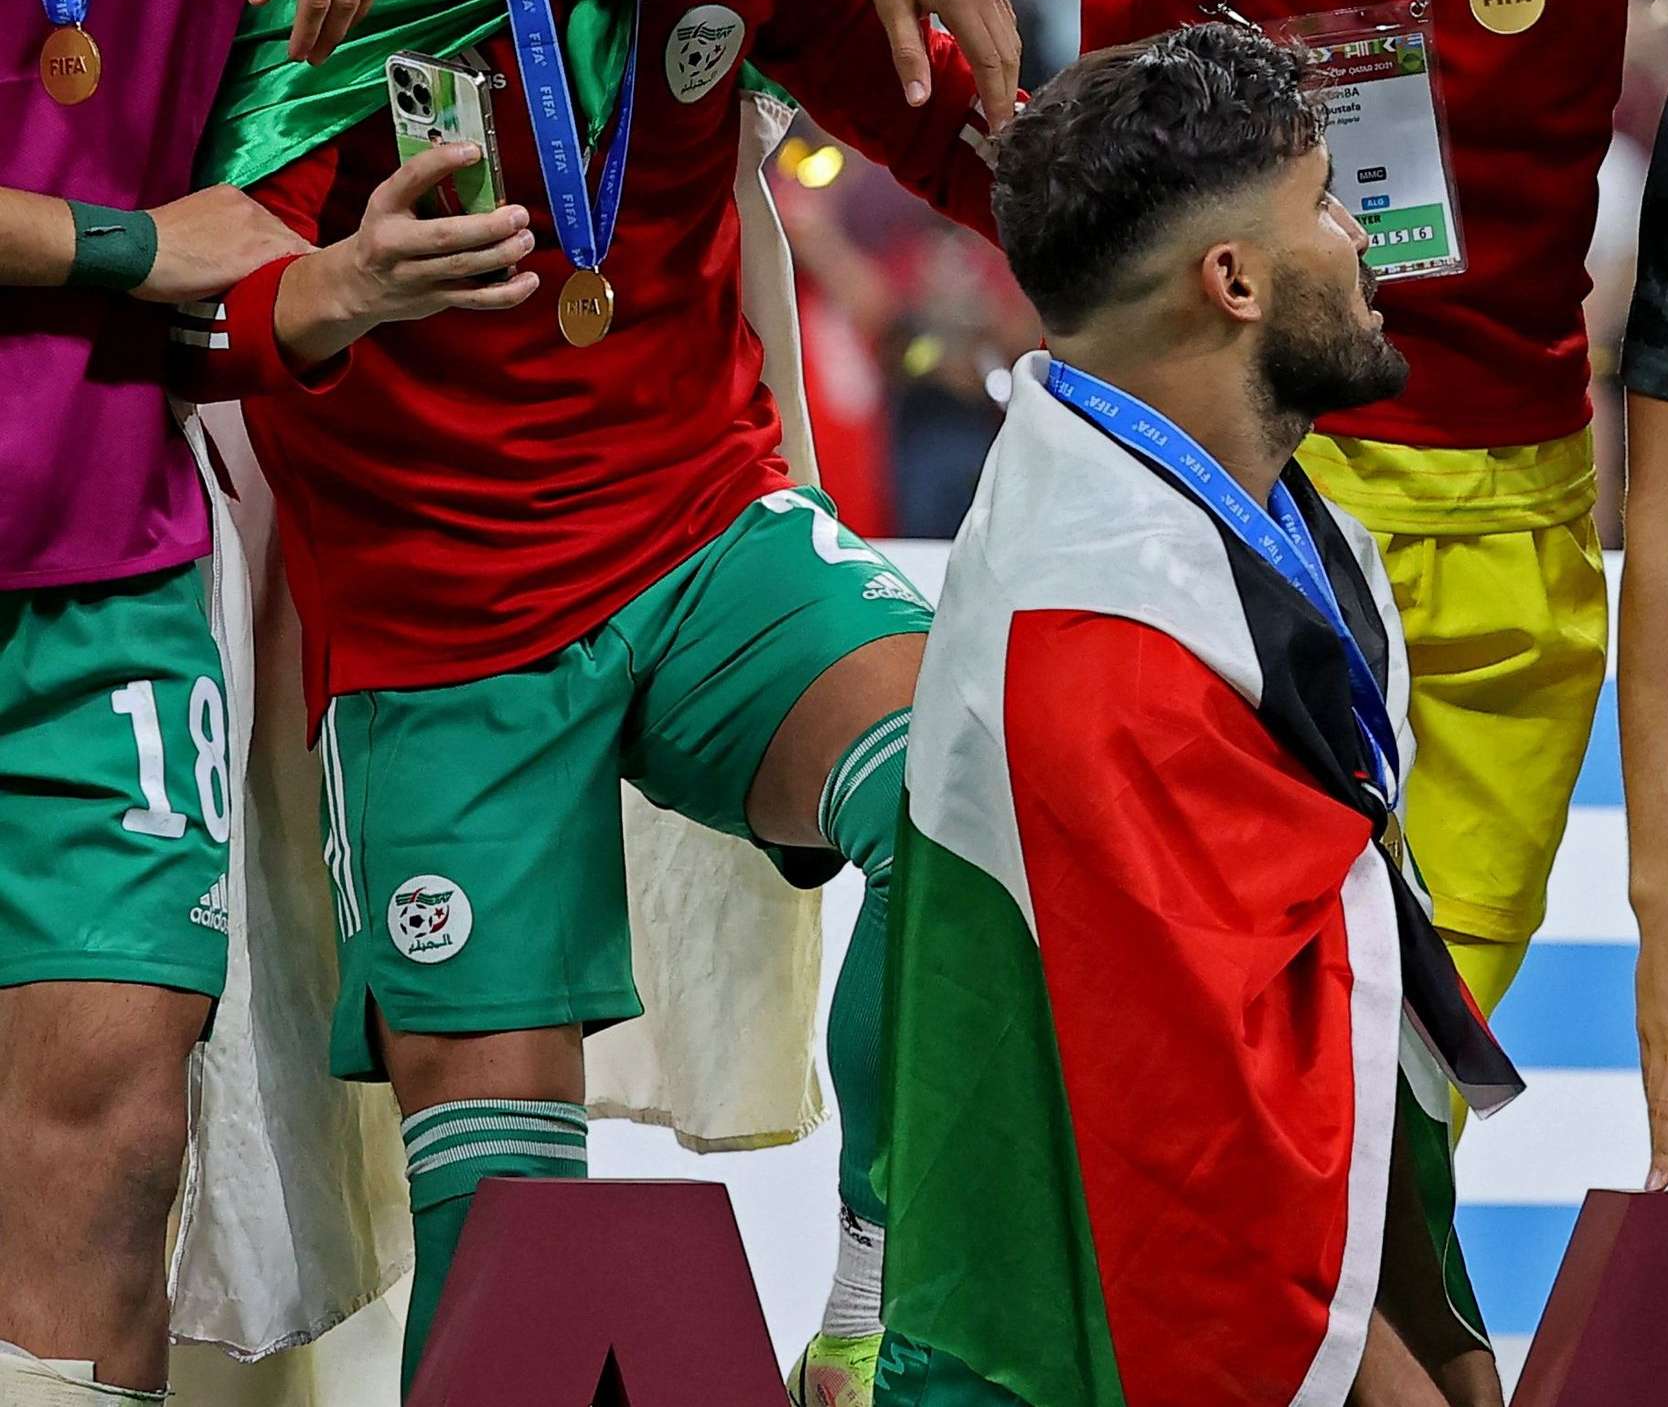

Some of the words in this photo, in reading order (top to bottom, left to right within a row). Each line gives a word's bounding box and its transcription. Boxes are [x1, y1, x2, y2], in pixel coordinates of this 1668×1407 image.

[529, 33, 546, 66] FIFA
[50, 56, 87, 76] FIFA
[540, 86, 557, 120] FIFA
[552, 140, 567, 174] FIFA
[1359, 169, 1384, 180] MMC
[563, 194, 577, 228] FIFA
[1355, 215, 1381, 225] AYER
[1371, 235, 1379, 245] 4
[1396, 232, 1403, 242] 5
[1420, 228, 1427, 239] 6
[1085, 395, 1120, 417] FIFA
[1133, 420, 1168, 447] FIFA
[1180, 454, 1211, 483] FIFA
[1221, 494, 1251, 524] FIFA
[1260, 535, 1283, 565] FIFA
[111, 675, 231, 843] 18
[190, 907, 230, 935] adida
